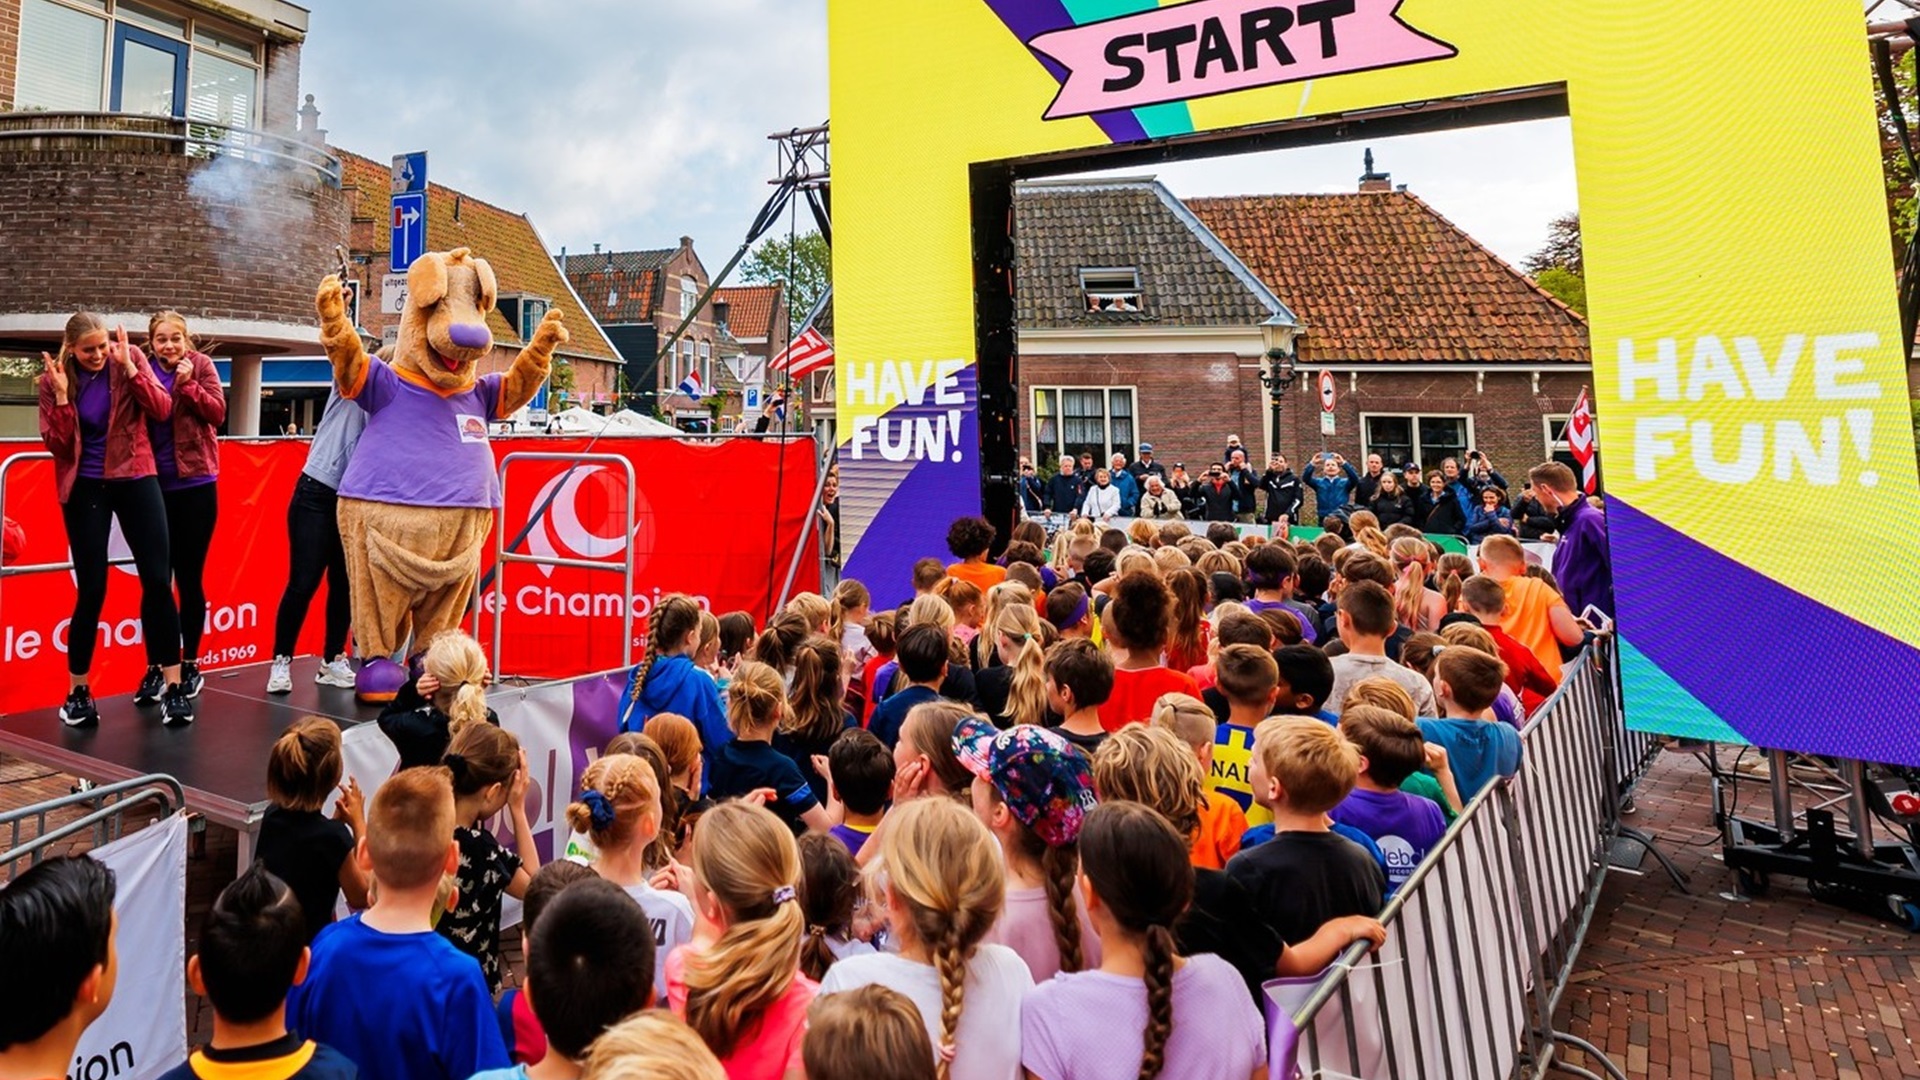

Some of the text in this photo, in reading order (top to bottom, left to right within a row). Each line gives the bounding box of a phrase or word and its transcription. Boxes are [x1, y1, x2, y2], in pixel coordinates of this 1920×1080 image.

[1102, 0, 1356, 92] START
[846, 358, 966, 406] HAVE
[1617, 331, 1882, 401] HAVE
[851, 409, 963, 463] FUN!
[1634, 408, 1880, 487] FUN!
[4, 625, 42, 662] le
[221, 644, 257, 662] 1969
